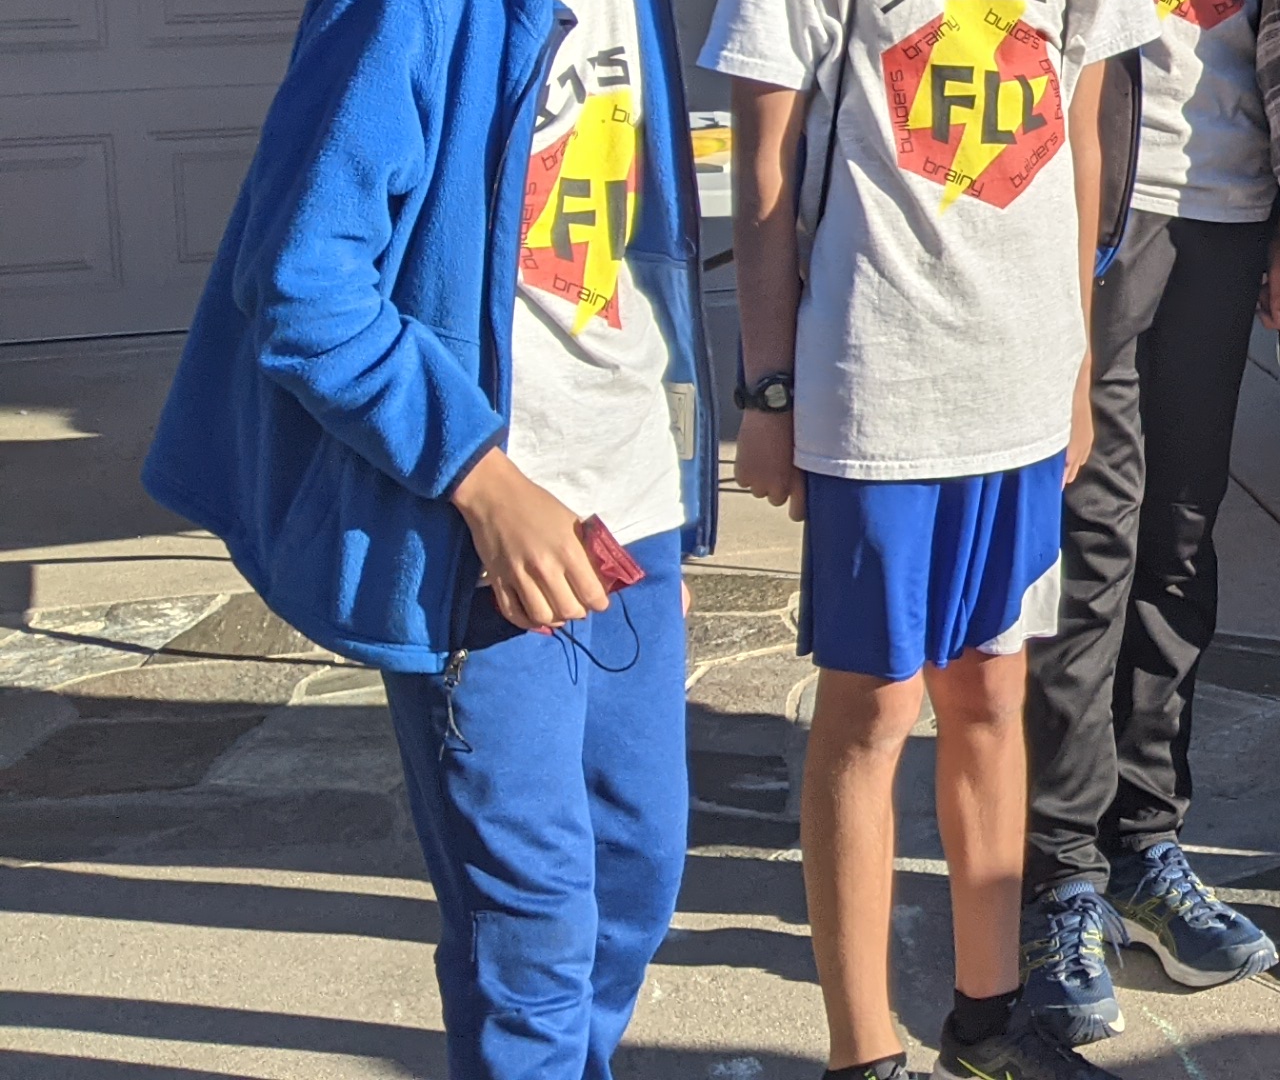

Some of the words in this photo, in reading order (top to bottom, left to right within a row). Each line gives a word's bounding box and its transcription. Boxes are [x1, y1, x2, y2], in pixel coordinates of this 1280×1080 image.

[903, 15, 961, 60] brainy
[890, 69, 914, 154] builders
[930, 63, 1048, 145] FLL
[923, 156, 985, 198] brainy
[1009, 132, 1058, 189] builders
